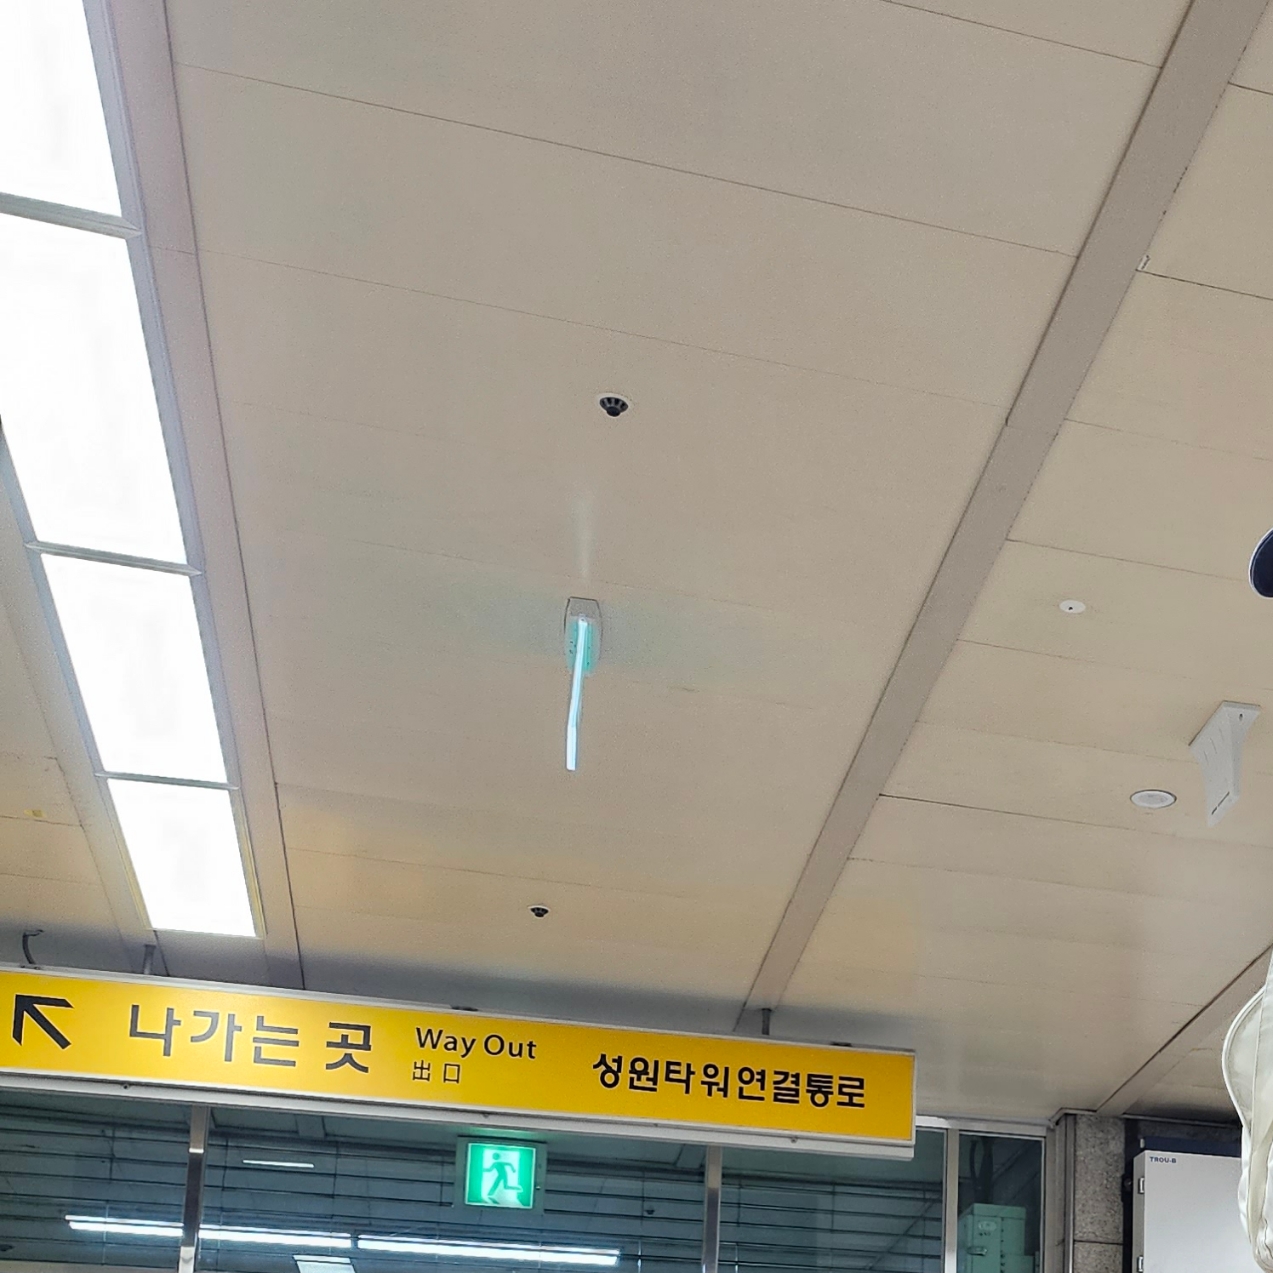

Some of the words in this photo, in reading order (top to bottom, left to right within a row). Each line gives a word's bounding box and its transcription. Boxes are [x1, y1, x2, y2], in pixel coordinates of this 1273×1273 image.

[129, 1004, 300, 1067] 나가는
[325, 1021, 372, 1073] 곳
[416, 1028, 476, 1058] Way
[483, 1034, 536, 1059] Out
[412, 1060, 460, 1084] 出口
[593, 1053, 865, 1108] 성원타워연결통로
